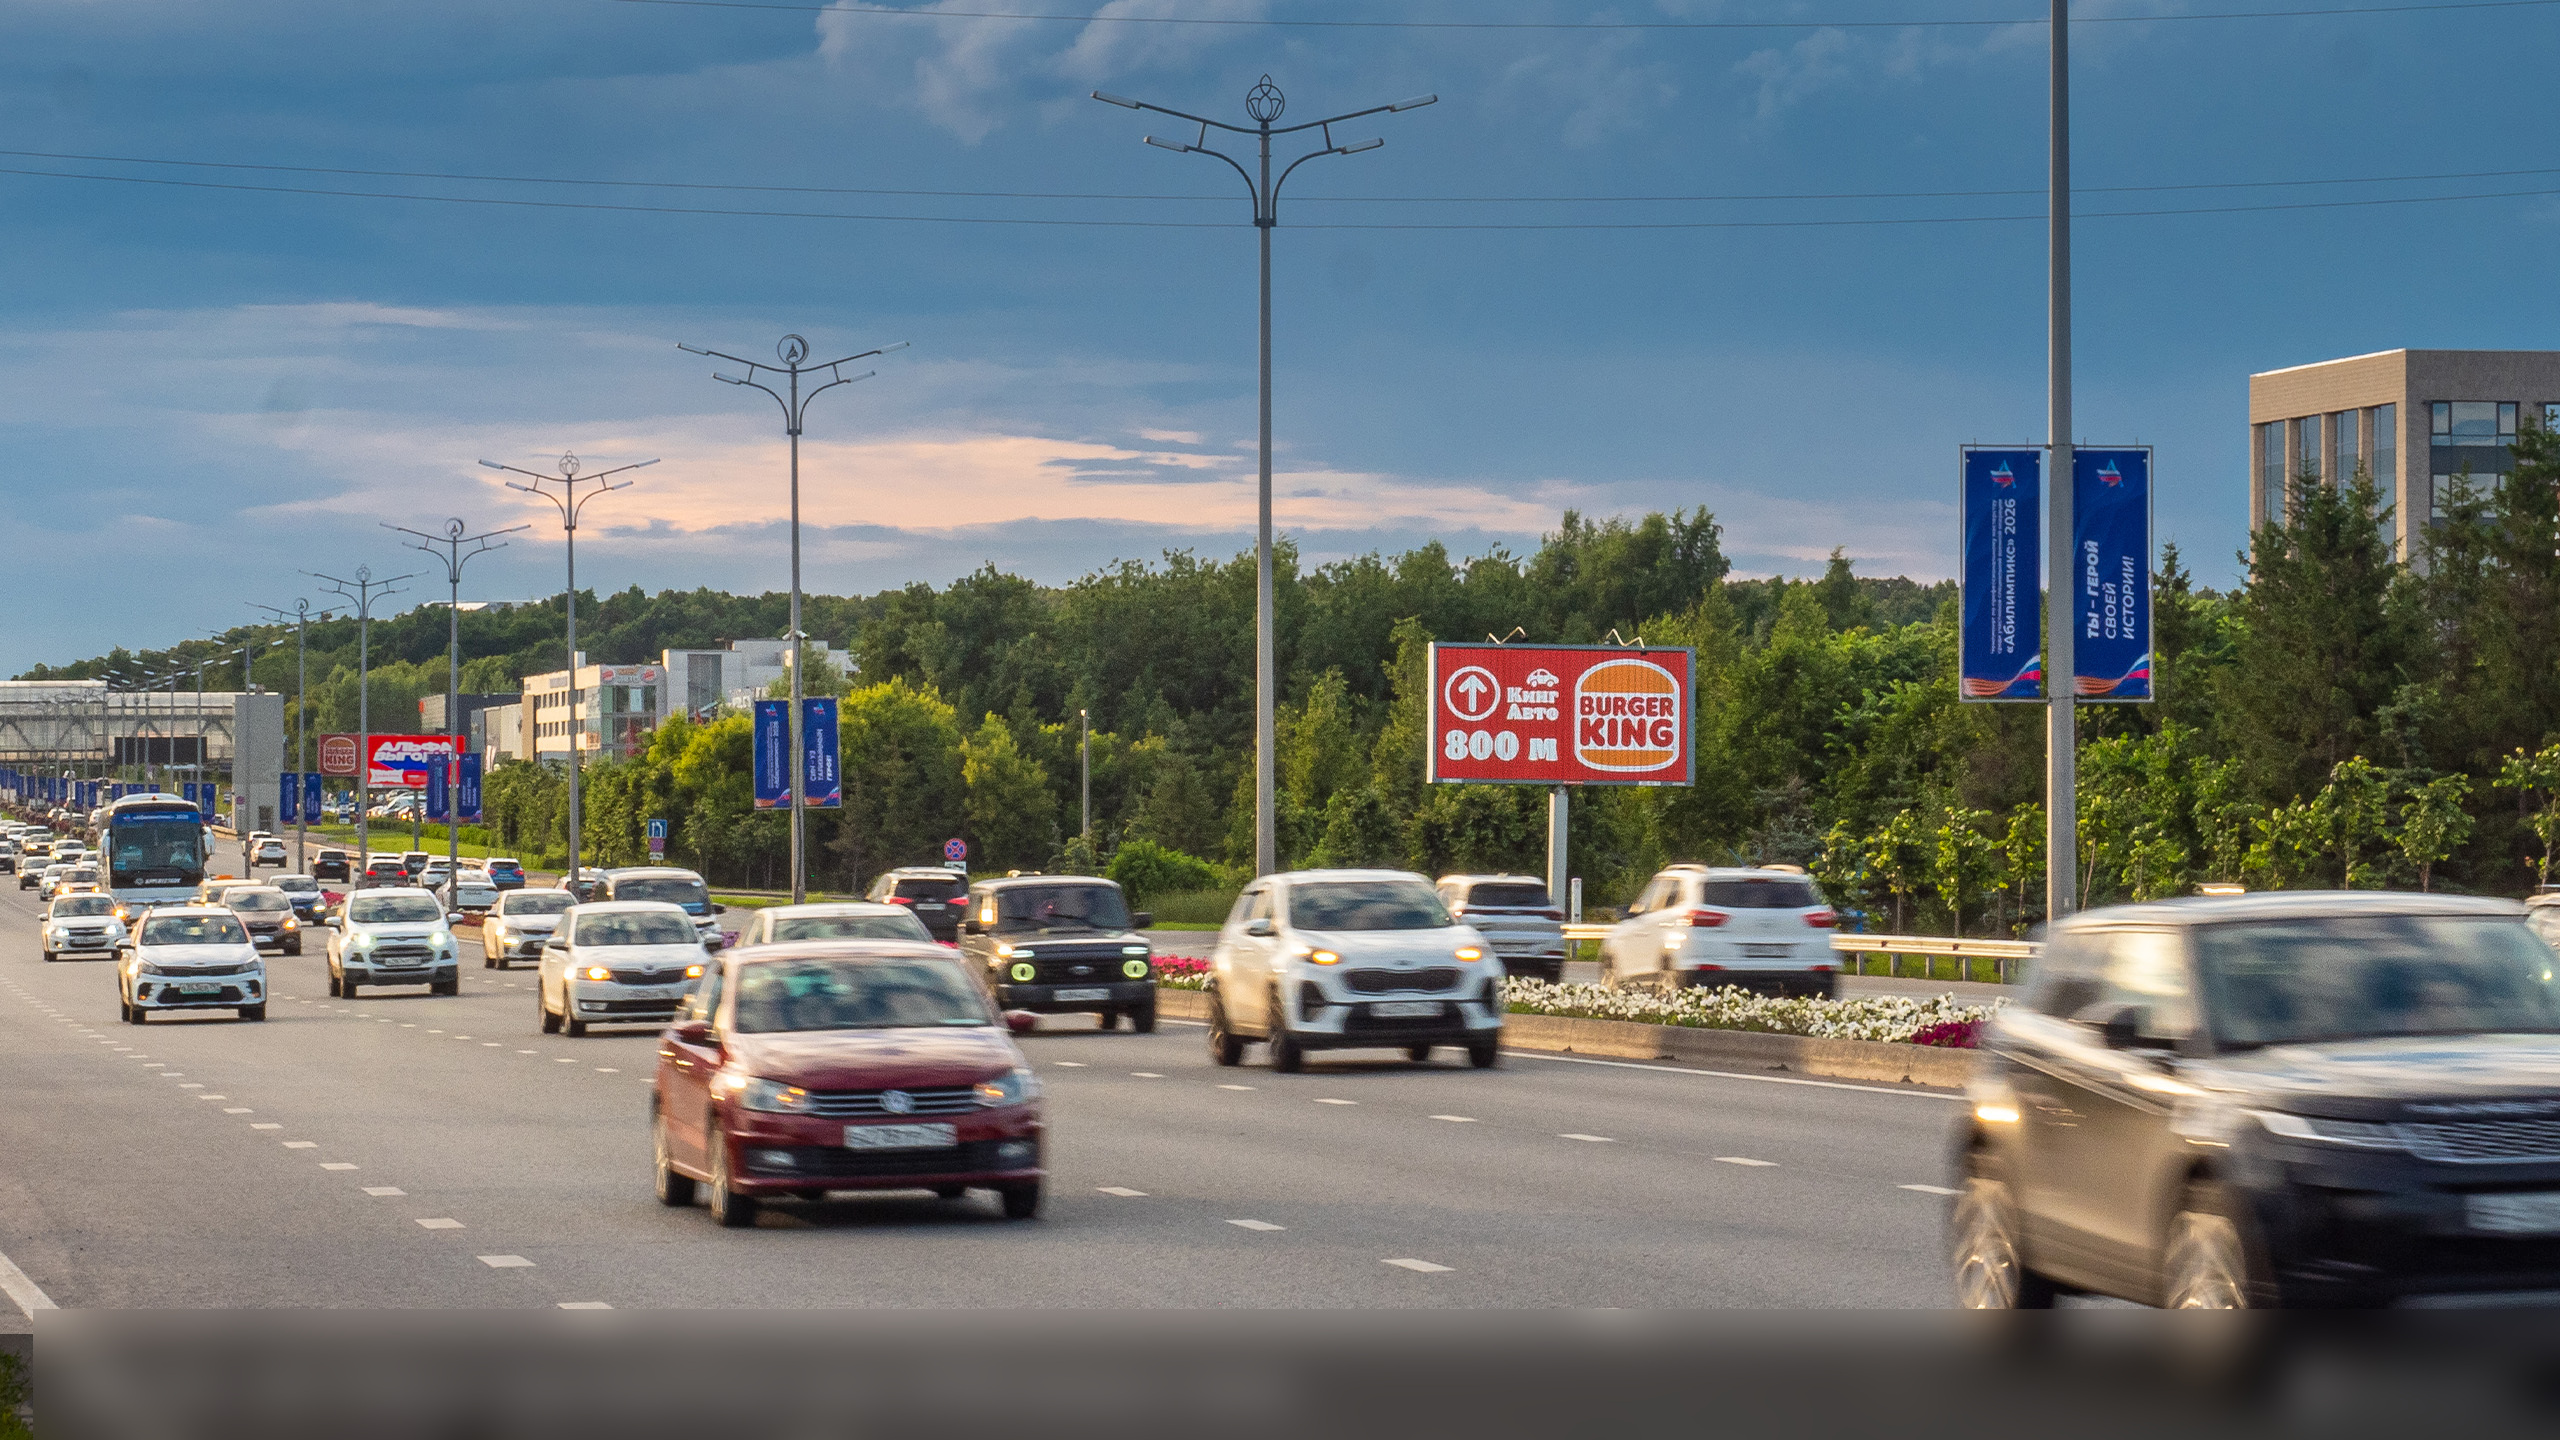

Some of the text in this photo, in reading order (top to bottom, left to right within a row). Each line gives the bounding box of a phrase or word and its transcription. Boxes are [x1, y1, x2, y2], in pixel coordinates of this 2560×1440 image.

[2003, 498, 2016, 654] «Абилимпикс» 2026
[2084, 540, 2099, 597] ГЕРОЙ
[2103, 582, 2117, 640] СВОЕЙ
[2122, 555, 2135, 640] ИСТОРИИ!
[2086, 612, 2099, 639] ТЫ
[1506, 686, 1559, 704] Кинг
[1580, 696, 1674, 717] BURGER
[1506, 704, 1560, 721] Авто
[377, 741, 452, 752] АЛЬФА
[1444, 730, 1519, 761] 800
[1580, 717, 1674, 747] KING
